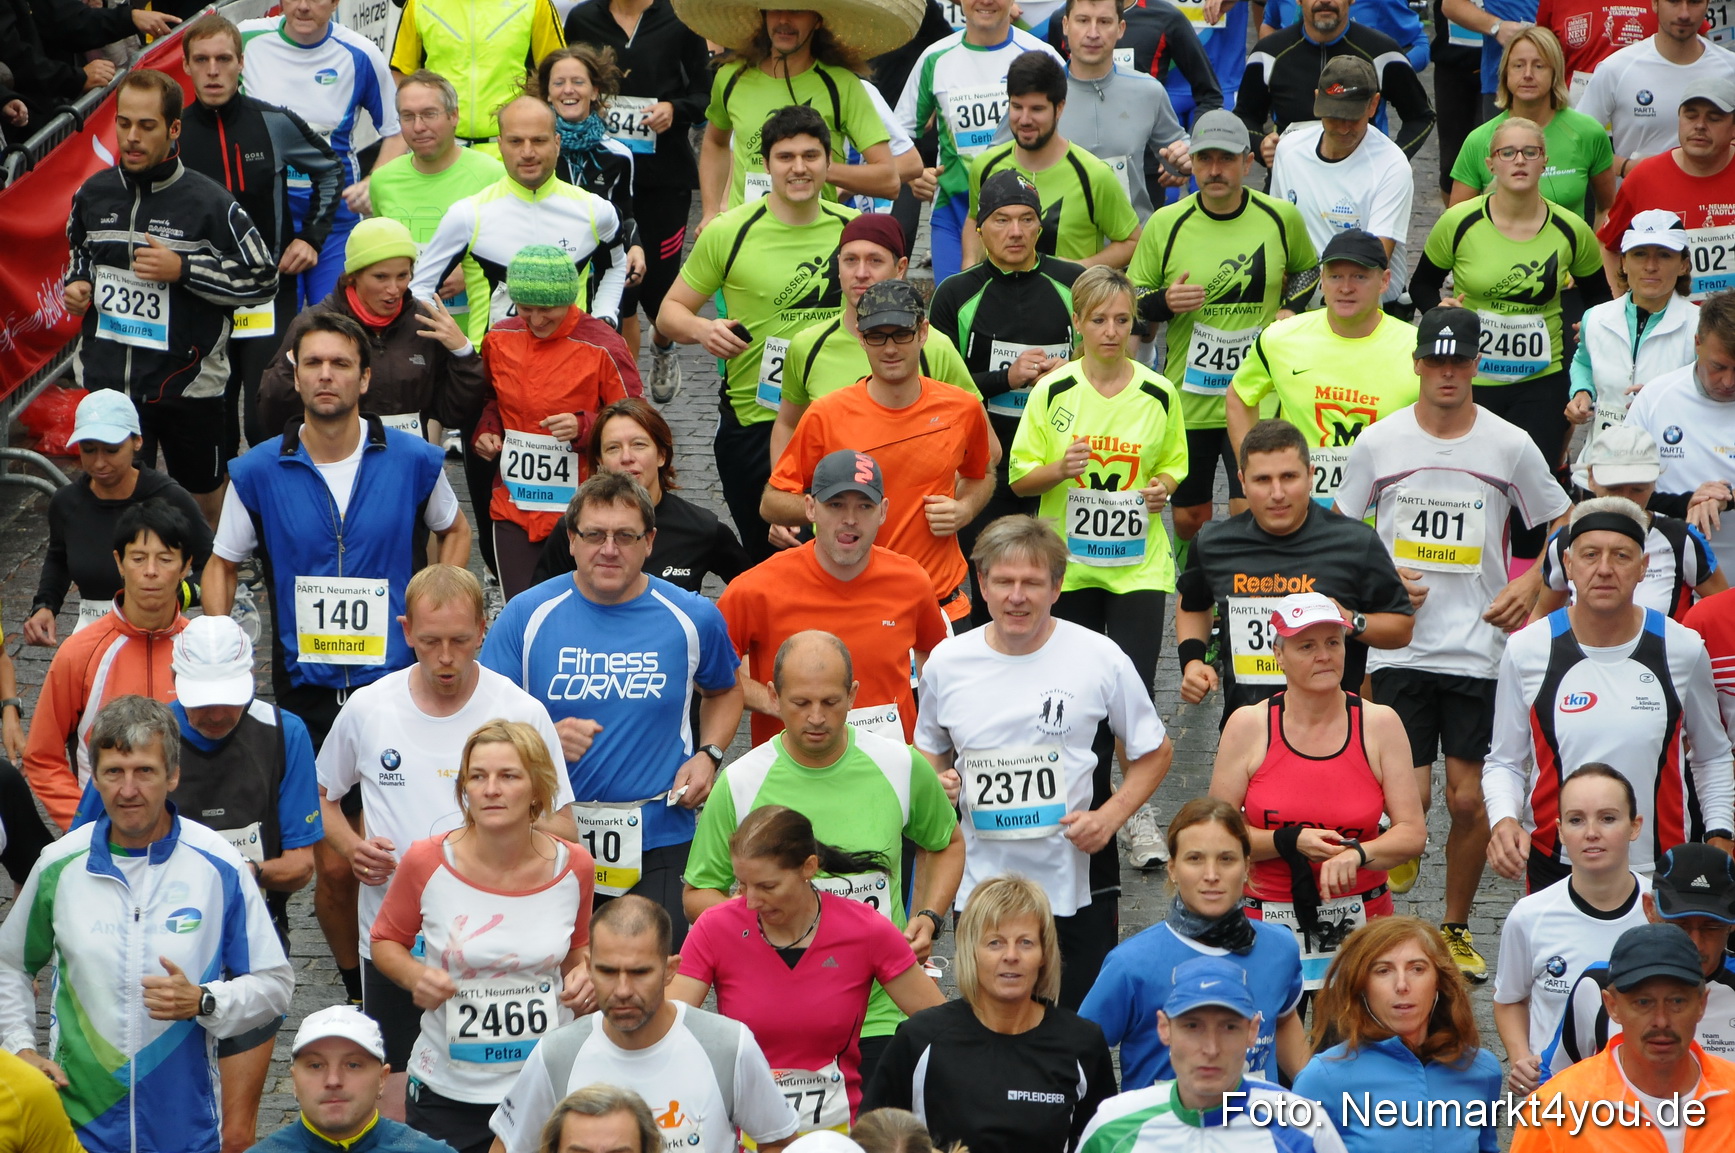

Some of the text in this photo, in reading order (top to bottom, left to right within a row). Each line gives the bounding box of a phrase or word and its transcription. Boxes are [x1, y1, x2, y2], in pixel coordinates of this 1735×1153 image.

[1610, 6, 1647, 14] NEUMARKTER
[1569, 29, 1586, 40] NEU
[971, 132, 995, 144] Gerh
[245, 152, 263, 160] GORE
[747, 179, 771, 187] PARTL
[1697, 233, 1735, 244] Neumarkt
[97, 271, 154, 289] PARTL Neumarkt
[1483, 271, 1522, 298] GOSSEN
[1698, 280, 1728, 290] Franz
[773, 270, 809, 306] GOSSEN
[101, 284, 161, 320] 2323
[1203, 305, 1263, 317] METRAWATT
[1501, 322, 1537, 330] Neumarkt
[1194, 328, 1250, 345] PARTL Neumarkt
[1479, 330, 1544, 358] 2460
[993, 347, 1019, 359] PARTL
[1483, 361, 1536, 373] Alexandra
[1314, 385, 1379, 406] Müller
[506, 436, 563, 452] PARTL Neumarkt
[1660, 446, 1685, 454] PARTL
[507, 450, 570, 482] 2054
[517, 487, 554, 500] Marina
[1068, 495, 1133, 508] PARTL Neumarkt
[1397, 495, 1471, 509] PARTL Neumarkt
[1074, 508, 1142, 537] 2026
[1411, 510, 1465, 541] 401
[1087, 544, 1126, 556] Monika
[1417, 546, 1457, 561] Harald
[672, 568, 691, 577] asics
[297, 585, 371, 595] PARTL Neumarkt
[1233, 573, 1316, 594] Reebok
[81, 607, 101, 617] PARTL
[313, 599, 368, 631] 140
[1230, 606, 1259, 615] PARTL
[314, 638, 365, 652] Bernhard
[558, 646, 659, 673] Fitness
[547, 673, 667, 700] CORNER
[1564, 693, 1588, 706] tkn
[966, 754, 1044, 770] PARTL Neumarkt
[379, 772, 405, 781] PARTL
[976, 768, 1056, 805] 2370
[577, 815, 623, 827] Neumarkt
[995, 811, 1040, 828] Konrad
[582, 830, 621, 864] 10
[1317, 907, 1347, 918] markt
[1544, 978, 1569, 989] PARTL
[488, 985, 536, 998] Neumarkt
[458, 999, 548, 1038] 2466
[485, 1047, 522, 1060] Petra
[1017, 1091, 1065, 1104] PFLEIDERER
